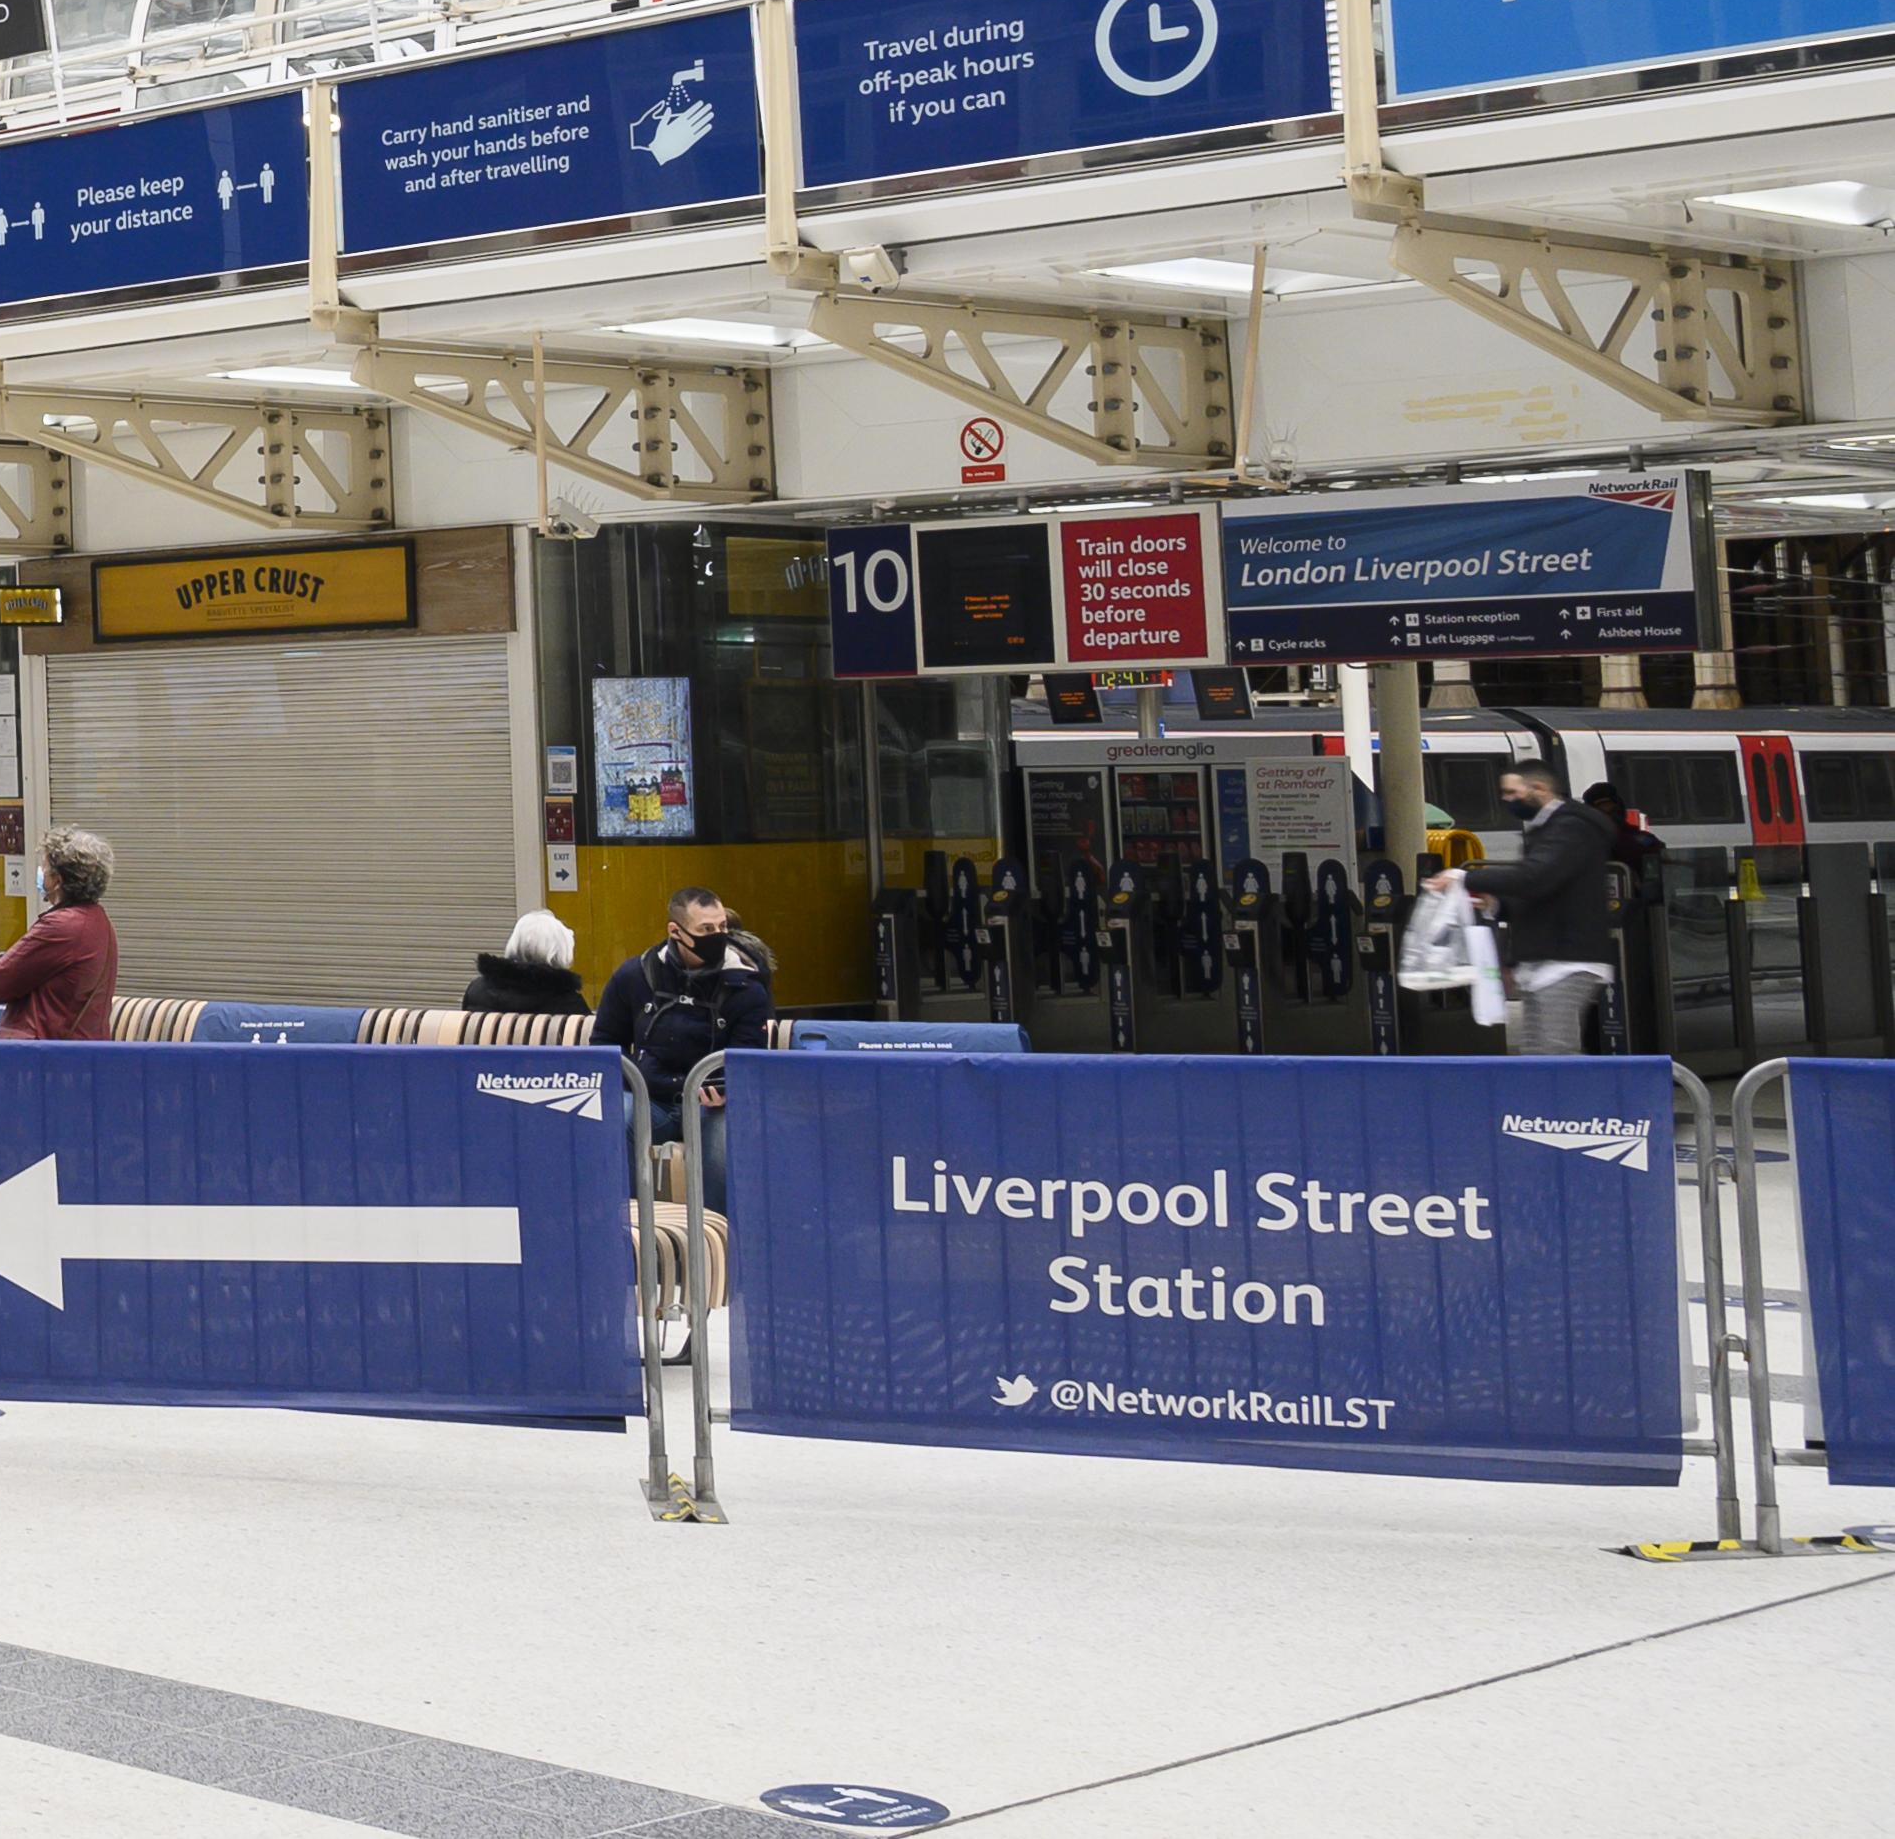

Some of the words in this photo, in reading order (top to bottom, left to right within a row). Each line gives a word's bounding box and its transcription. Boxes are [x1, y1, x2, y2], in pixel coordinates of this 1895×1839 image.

[864, 30, 937, 60] Travel
[944, 20, 1024, 47] during
[859, 61, 957, 94] off-peak
[964, 52, 1034, 77] hours
[890, 100, 905, 122] if
[911, 98, 955, 125] you
[963, 91, 1005, 110] can
[78, 185, 135, 207] Please
[141, 177, 184, 196] keep
[71, 218, 111, 243] your
[116, 206, 192, 230] distance
[1589, 477, 1677, 494] NetworkRail
[1077, 537, 1124, 555] Train
[1131, 535, 1186, 553] doors
[1241, 537, 1322, 554] Welcome
[1328, 536, 1346, 550] to
[834, 550, 908, 612] 10
[1079, 560, 1111, 578] will
[1118, 558, 1168, 576] close
[1242, 560, 1345, 586] London
[1355, 551, 1490, 585] Liverpool
[1498, 548, 1592, 574] Street
[176, 568, 247, 609] UPPER
[254, 567, 324, 602] CRUST
[1081, 583, 1104, 601] 30
[1111, 579, 1190, 599] seconds
[1082, 605, 1145, 623] before
[1425, 614, 1464, 624] Station
[1467, 612, 1519, 623] reception
[1597, 608, 1622, 617] First
[1625, 606, 1642, 616] aid
[1083, 629, 1180, 649] departure
[1598, 626, 1640, 638] Ashbee
[1644, 627, 1681, 636] House
[476, 1071, 604, 1094] NetworkRail
[1502, 1113, 1651, 1141] NetworkRail
[893, 1157, 1227, 1237] Liverpool
[1256, 1173, 1492, 1239] Street
[1049, 1256, 1324, 1325] Station
[1051, 1380, 1395, 1429] @NetworkRailLST
